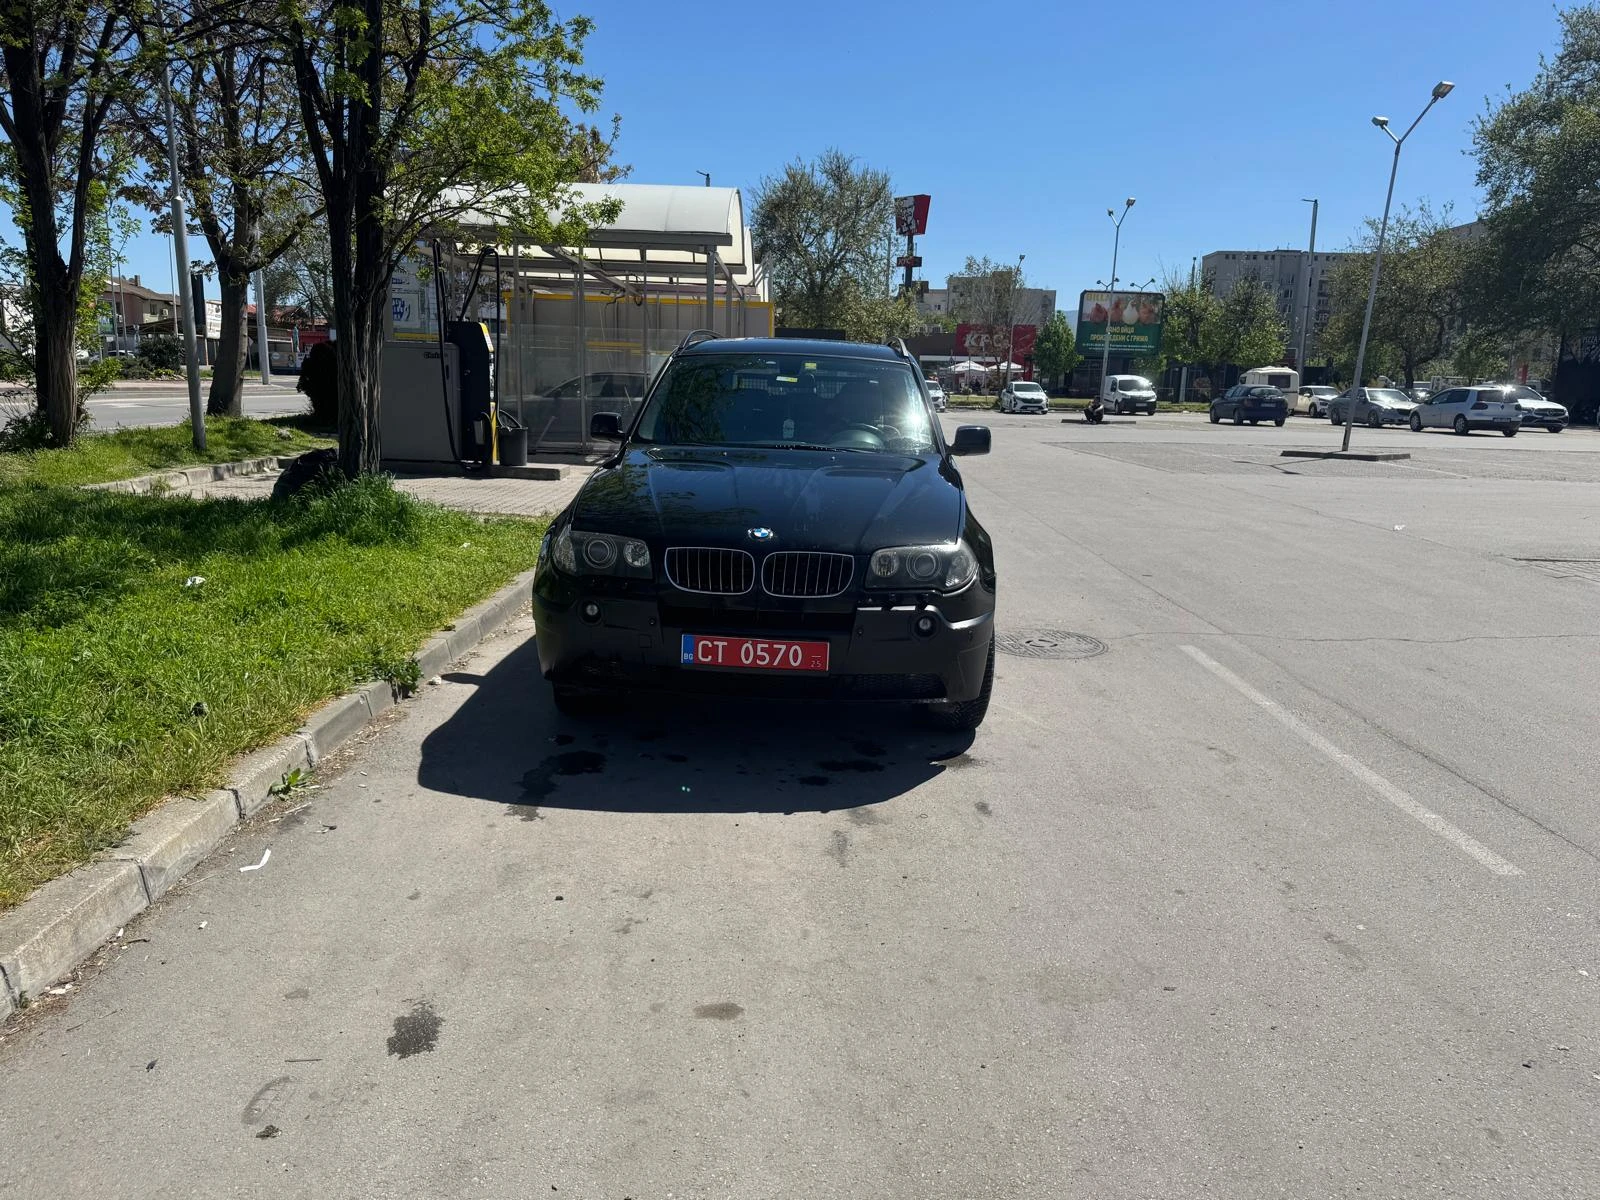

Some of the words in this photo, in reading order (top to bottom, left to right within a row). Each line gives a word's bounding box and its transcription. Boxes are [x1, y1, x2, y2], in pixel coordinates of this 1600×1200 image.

[697, 640, 728, 663] CT
[740, 642, 803, 667] 0570
[810, 660, 822, 668] 25
